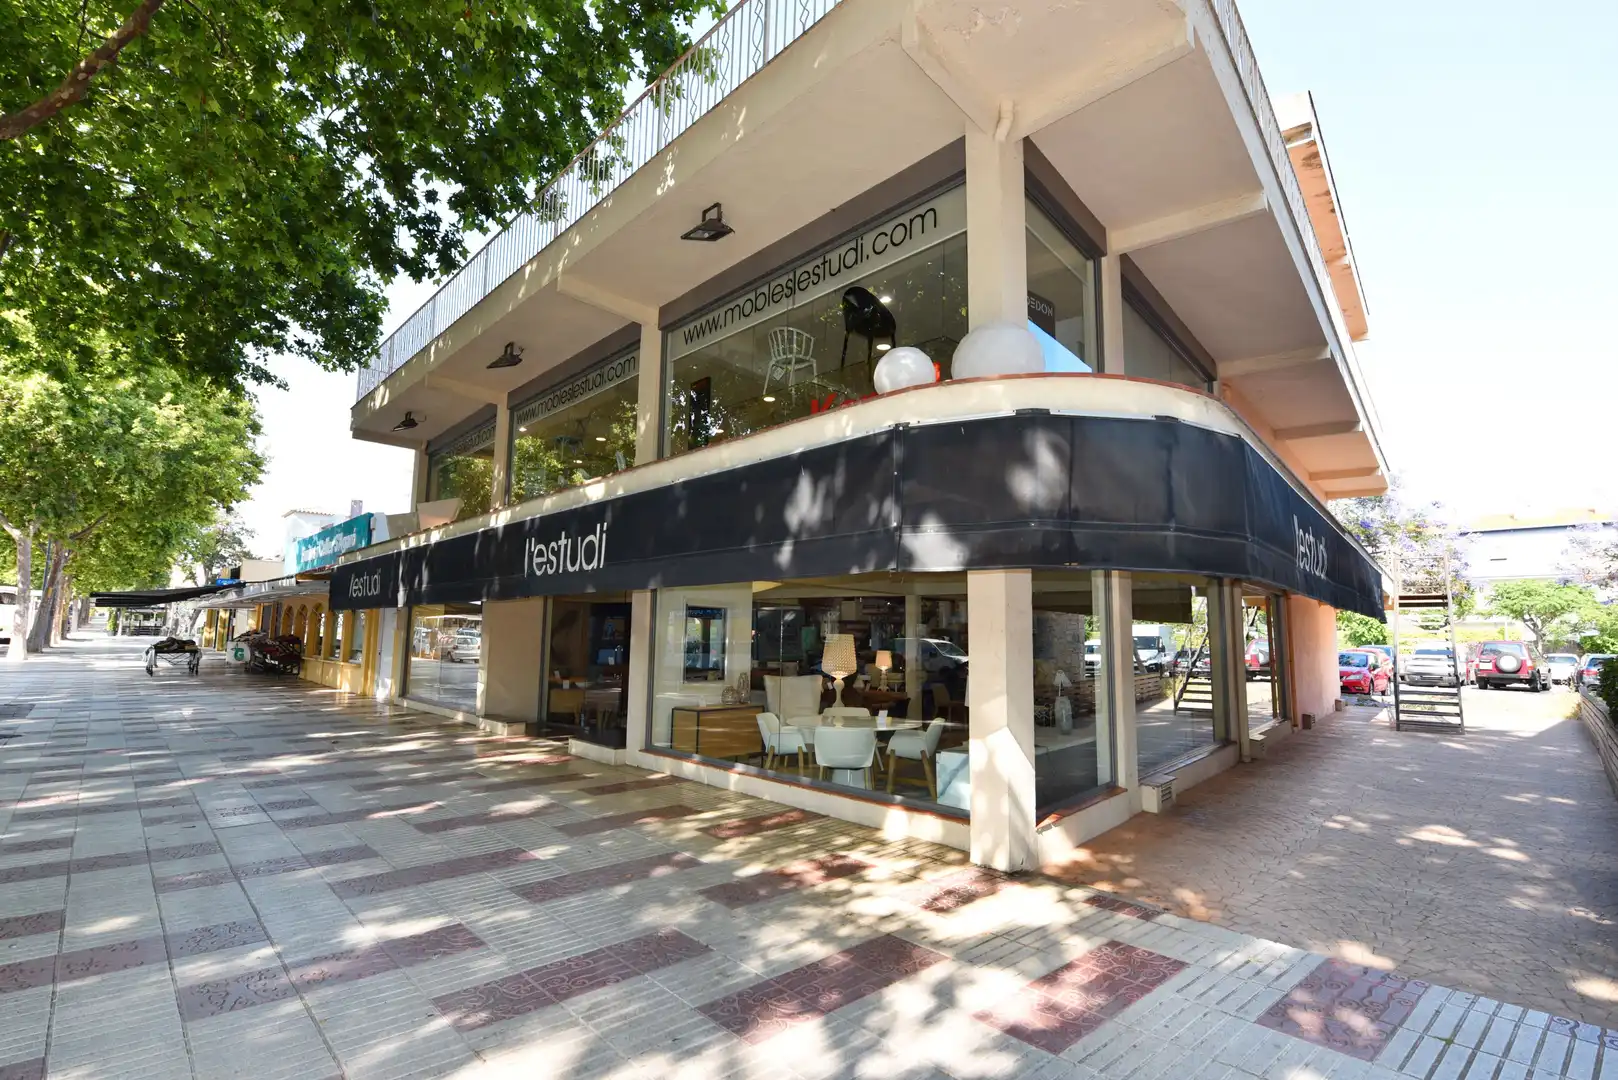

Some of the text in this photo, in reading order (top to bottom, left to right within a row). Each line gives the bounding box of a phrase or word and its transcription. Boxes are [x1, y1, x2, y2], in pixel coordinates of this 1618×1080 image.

[682, 206, 938, 346] www.mobleslestudi.com
[515, 355, 637, 425] www.mobleslestudi.com
[524, 522, 607, 578] l'estudi
